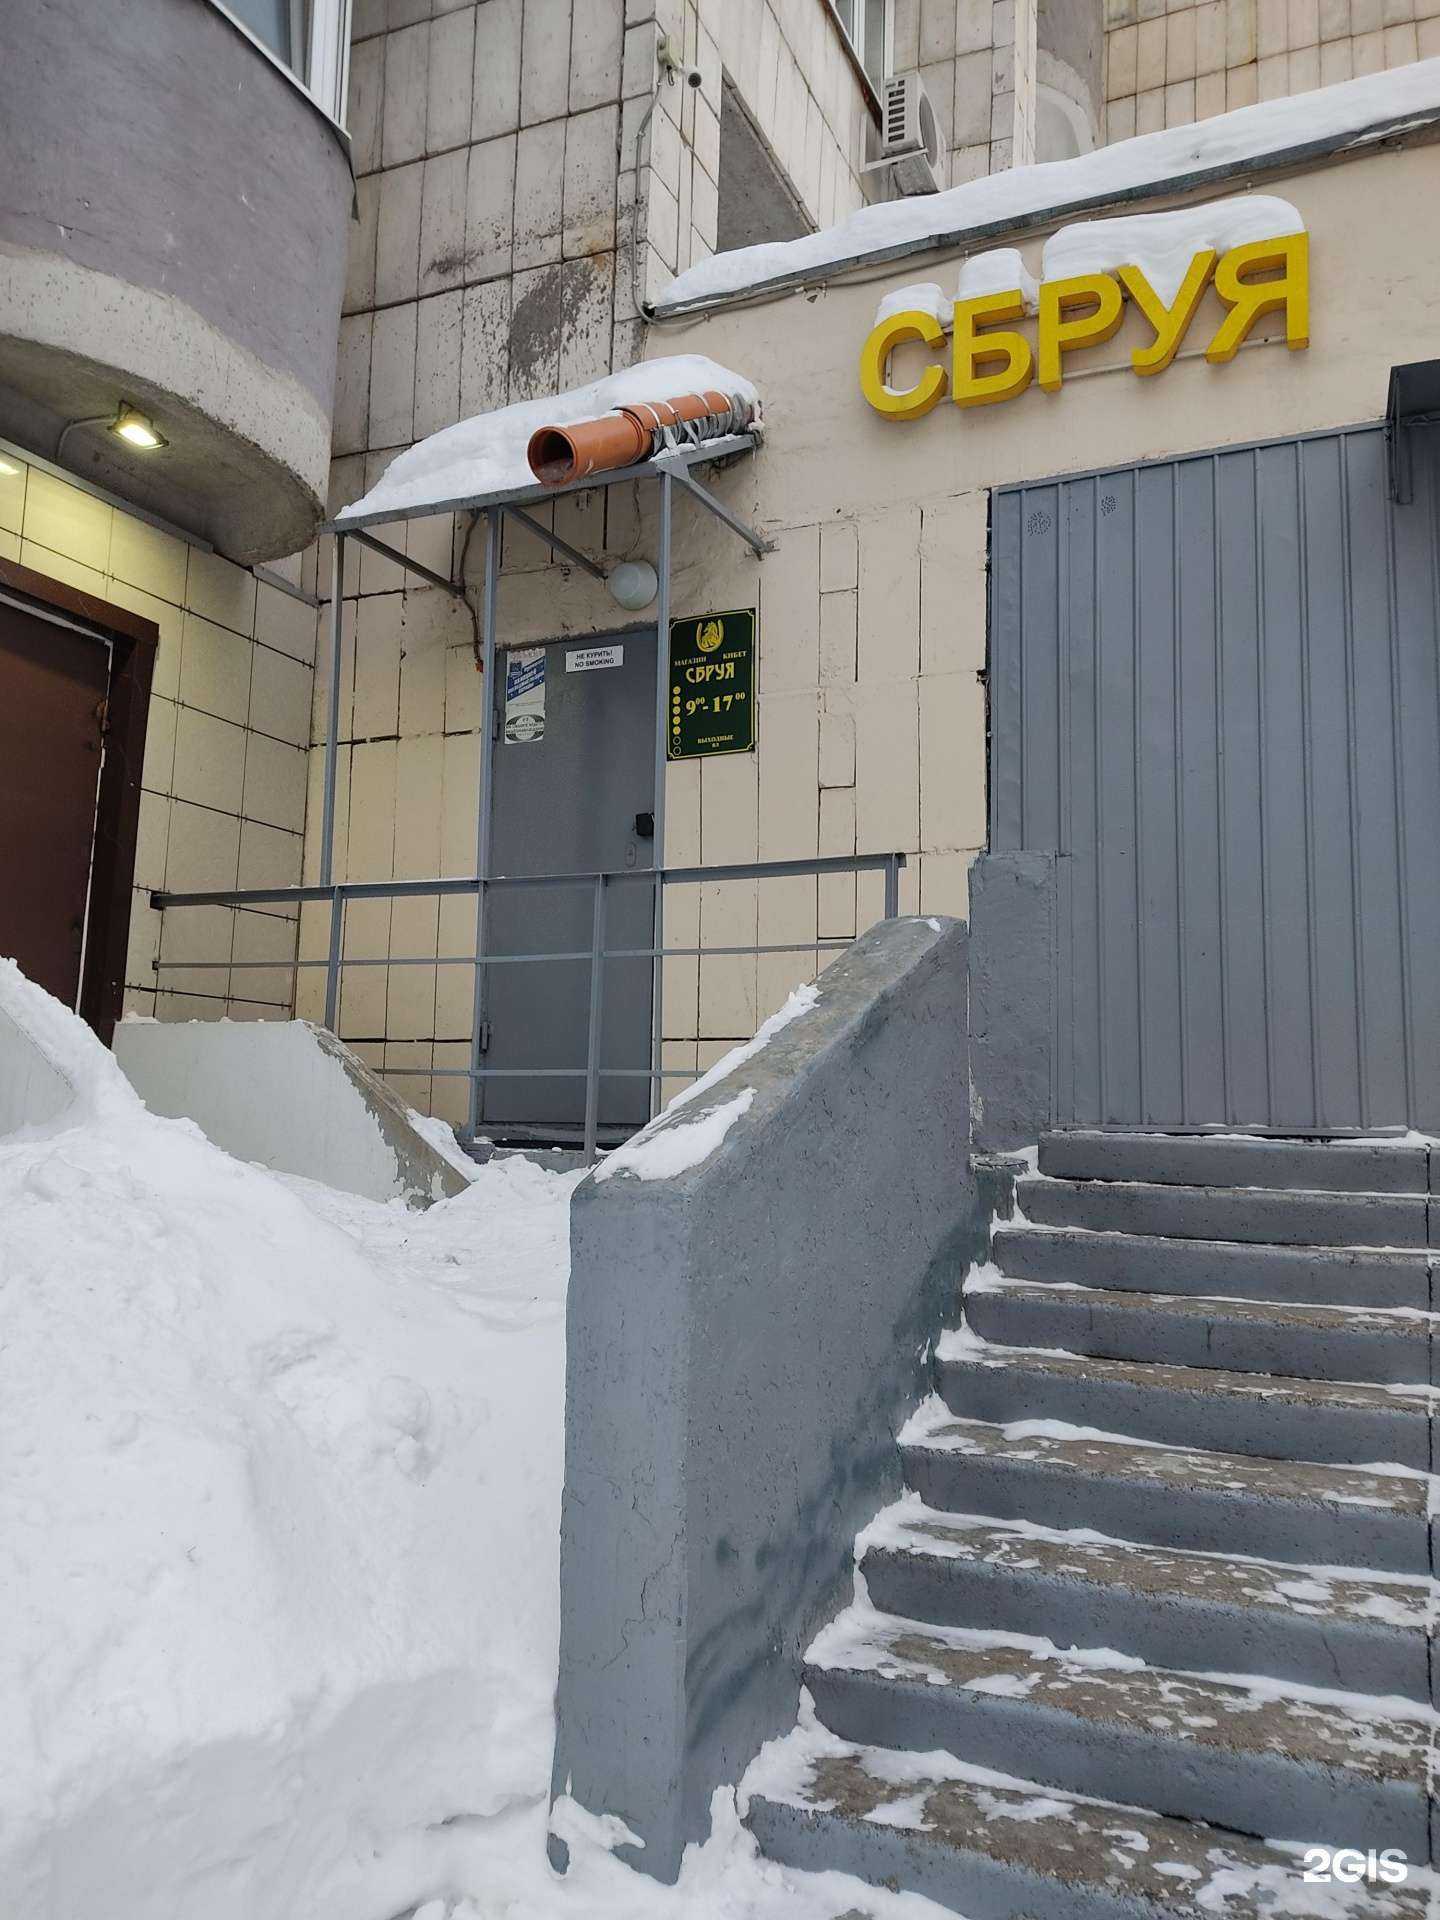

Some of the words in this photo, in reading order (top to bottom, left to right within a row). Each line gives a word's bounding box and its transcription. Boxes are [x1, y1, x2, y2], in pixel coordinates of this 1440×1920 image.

[860, 231, 1309, 421] СБРУЯ
[585, 657, 614, 667] SMOKING
[586, 650, 613, 659] КУРИТЬ!
[674, 655, 707, 667] МАГАЗИН
[723, 650, 747, 660] КИБЕТ
[685, 662, 735, 684] СБРУЯ
